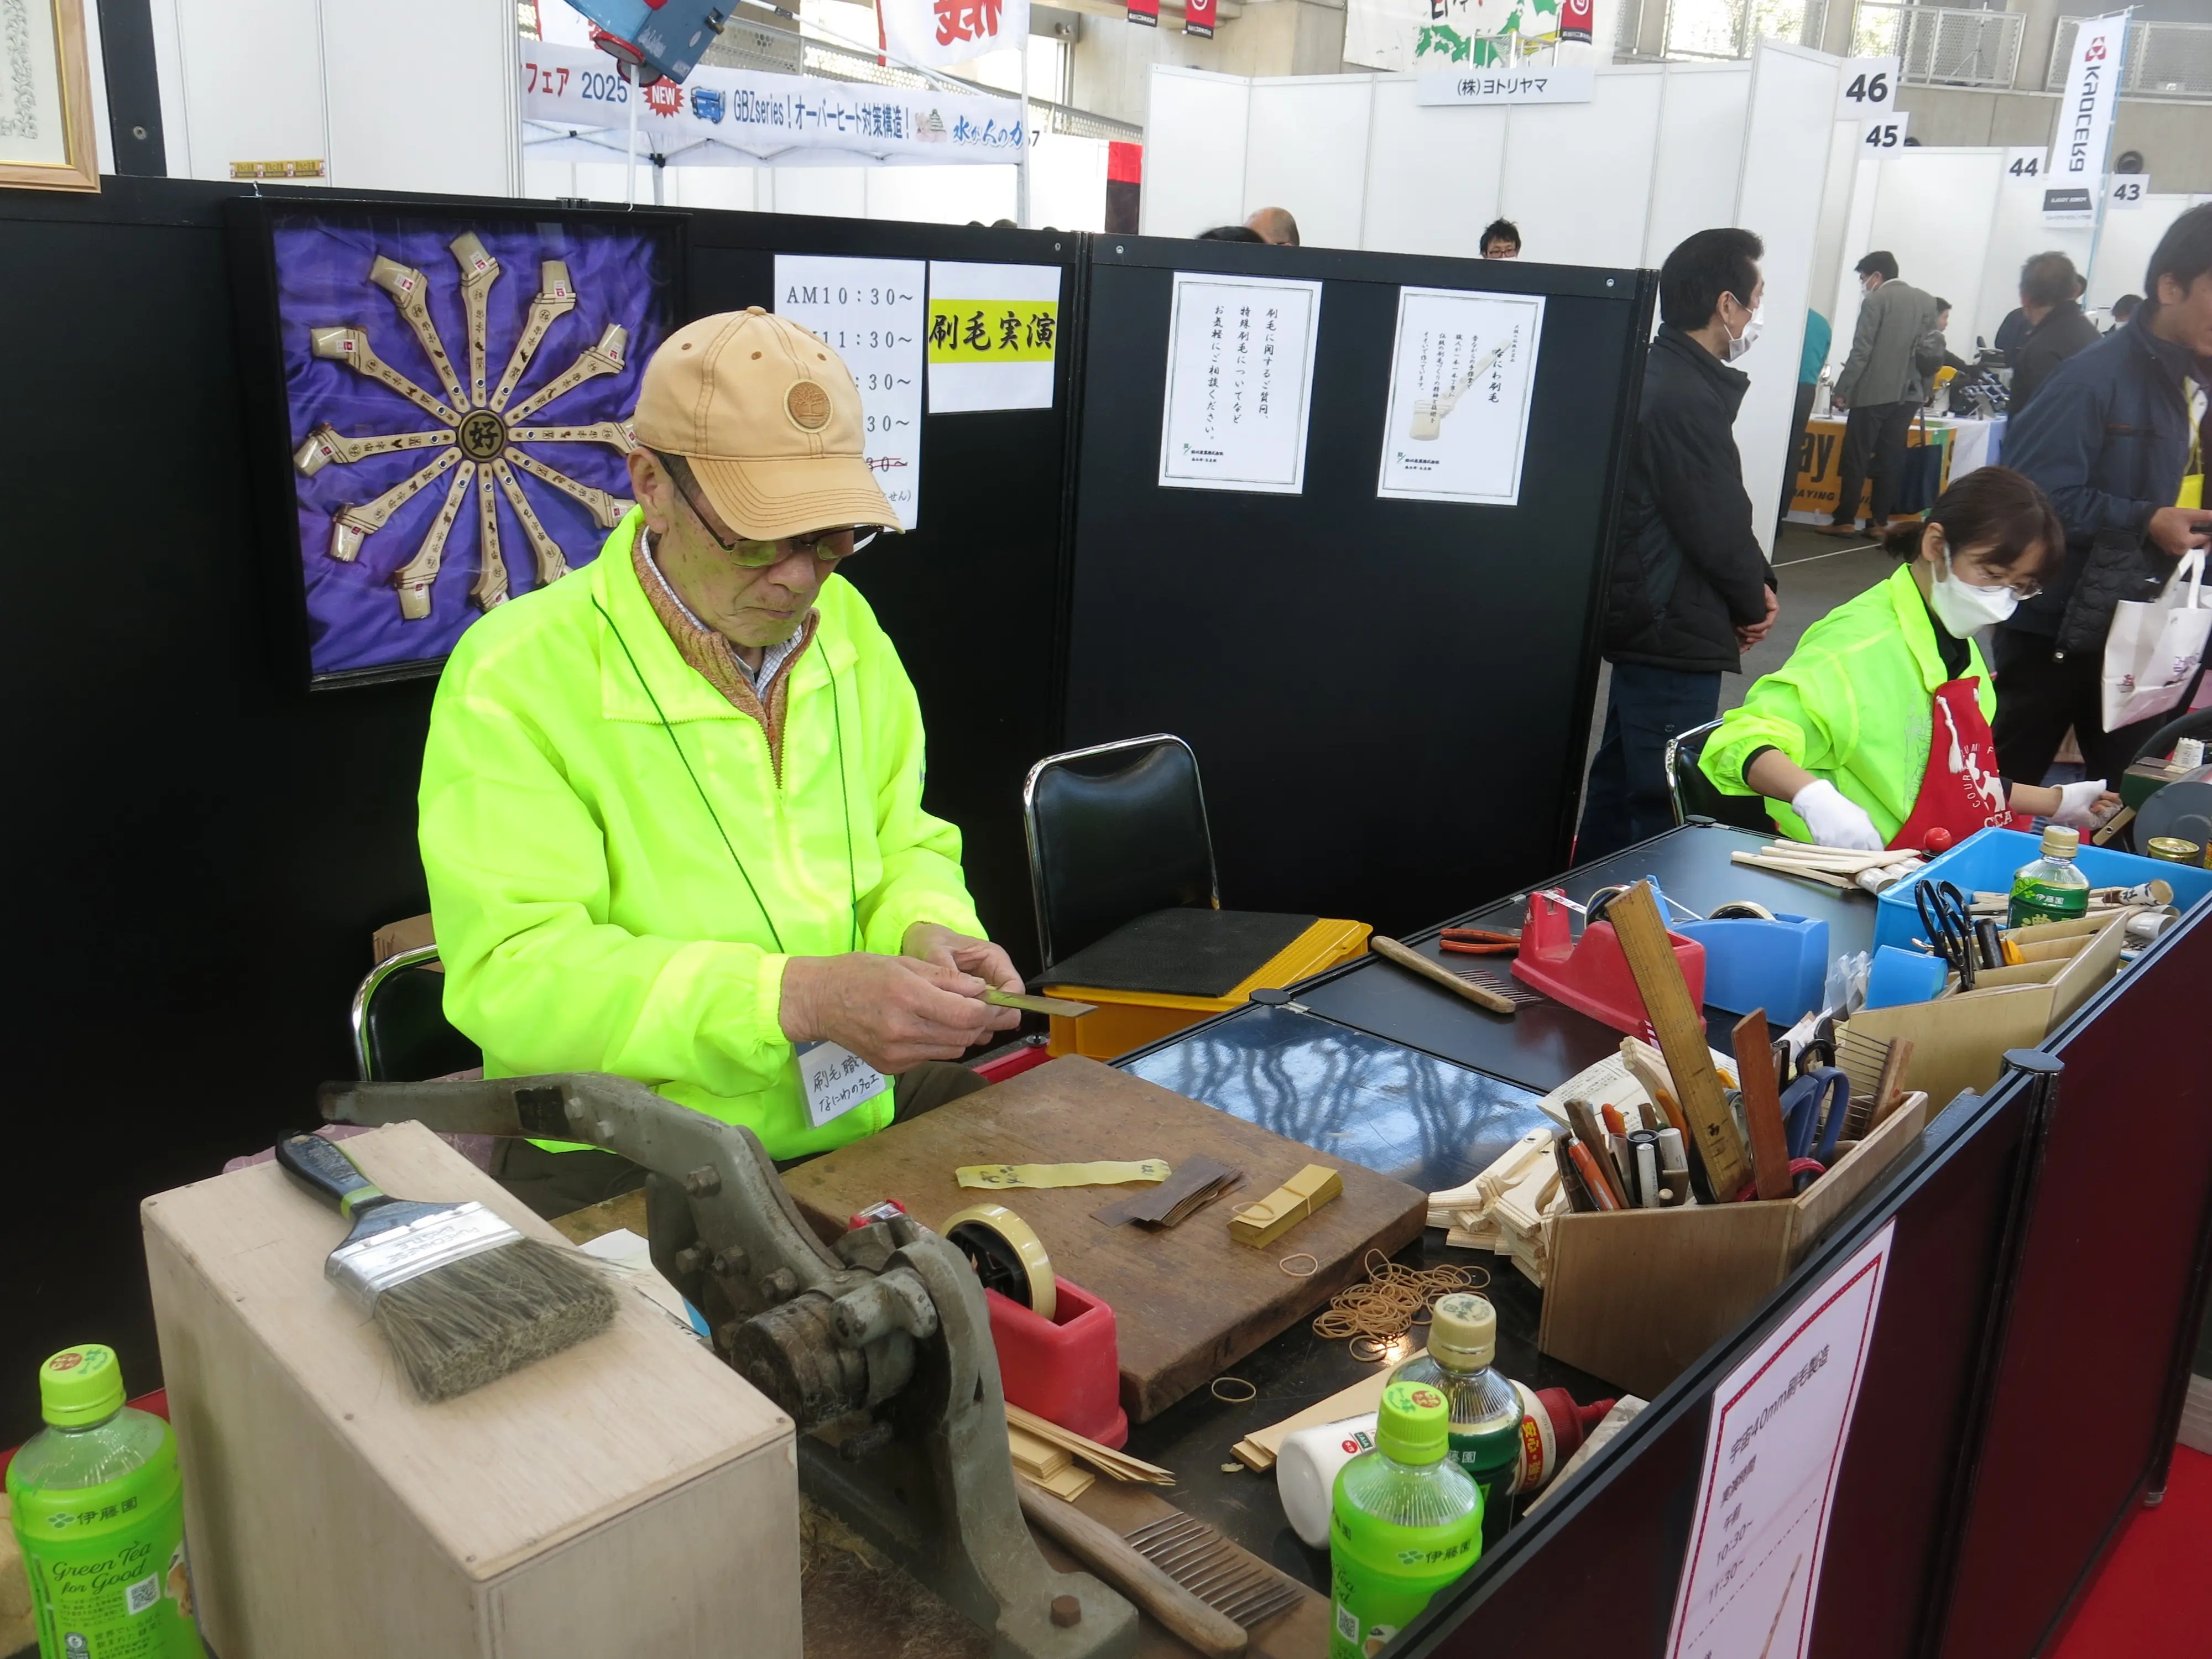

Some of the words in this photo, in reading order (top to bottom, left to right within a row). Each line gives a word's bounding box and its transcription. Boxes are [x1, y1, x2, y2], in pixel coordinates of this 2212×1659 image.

[525, 63, 569, 97] フェア
[582, 72, 628, 103] 2025
[651, 86, 676, 106] NEW
[1457, 78, 1548, 96] (株)ヨトリヤマ
[1846, 72, 1888, 103] 46
[1866, 124, 1898, 147] 45
[2009, 158, 2038, 176] 44
[2114, 184, 2140, 200] 43
[929, 310, 1056, 352] 刷毛実演
[1205, 306, 1224, 440] お気軽にご相談ください。
[1233, 306, 1251, 424] 特殊刷毛についてなど
[1488, 348, 1504, 403] なにわ刷毛
[469, 421, 499, 450] 好
[2036, 894, 2064, 905] 伊藤園
[1448, 1450, 1477, 1463] 藤園
[77, 1496, 137, 1525] 伊藤園
[53, 1559, 116, 1581] Green
[118, 1541, 152, 1566] Tea
[1426, 1538, 1472, 1564] 伊藤園
[61, 1582, 87, 1595] for
[92, 1558, 147, 1595] Good
